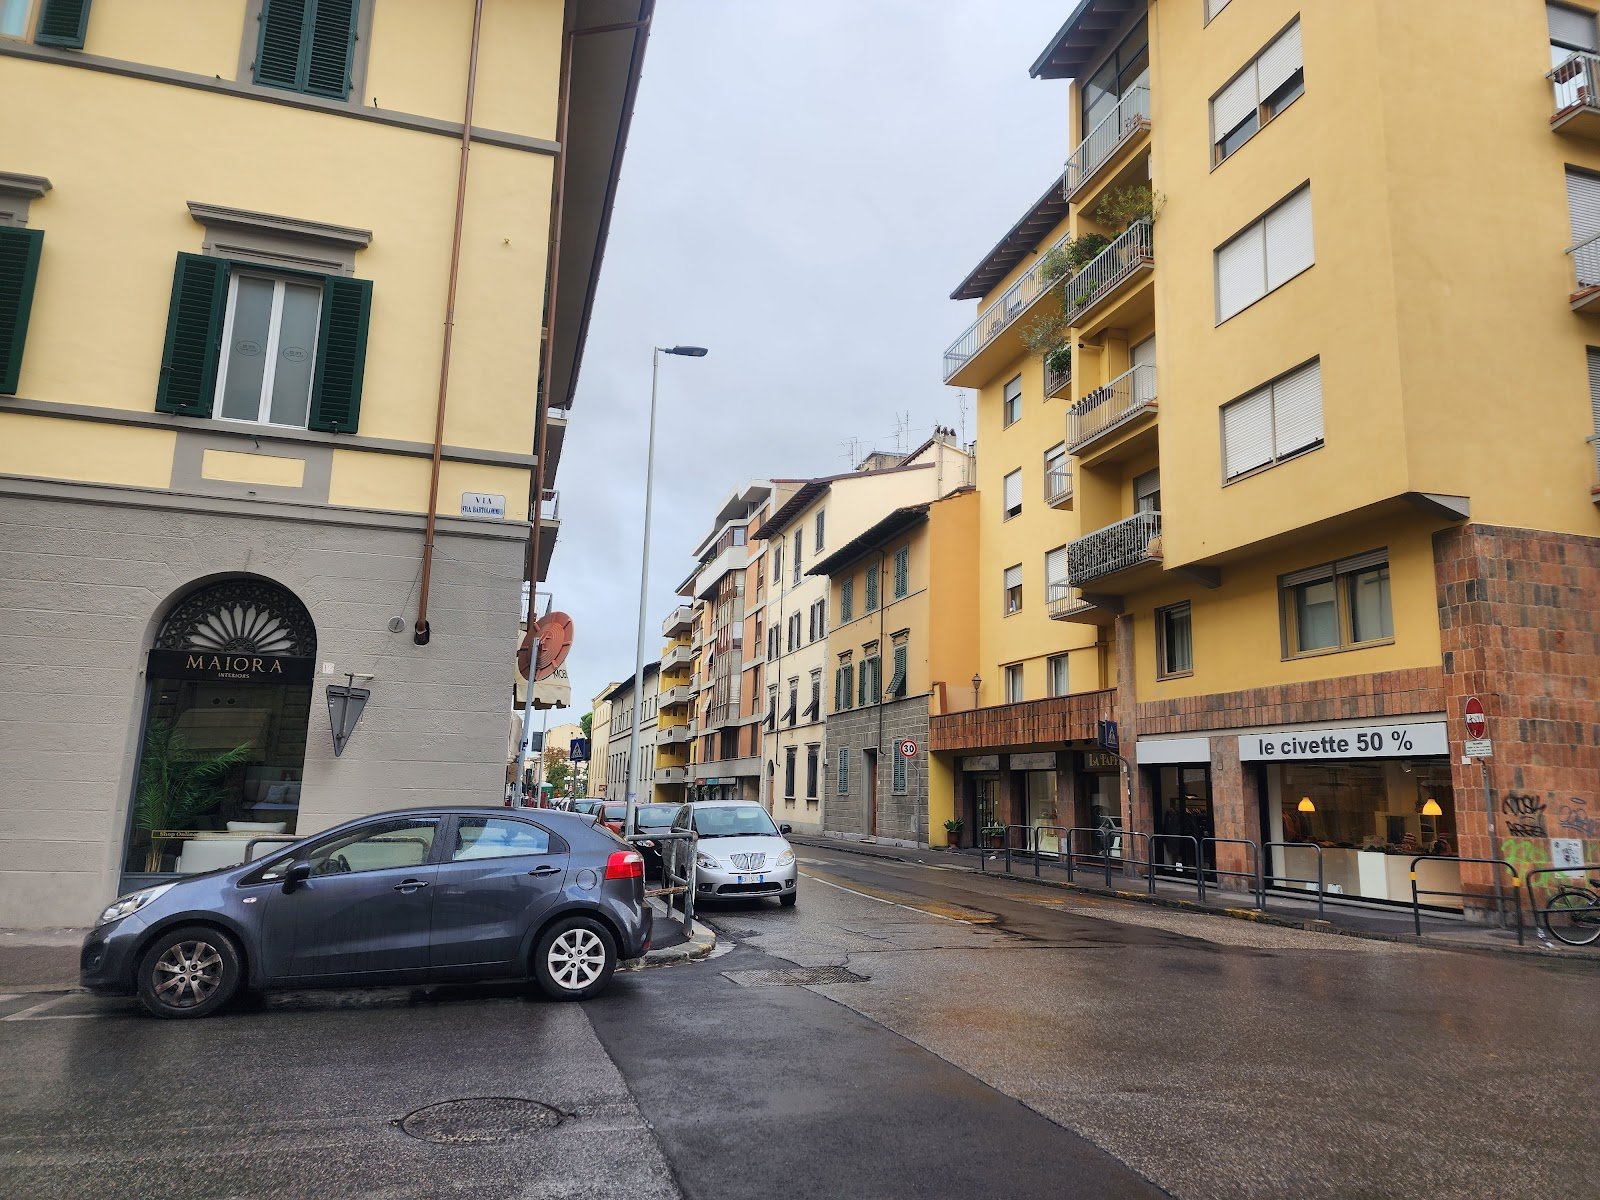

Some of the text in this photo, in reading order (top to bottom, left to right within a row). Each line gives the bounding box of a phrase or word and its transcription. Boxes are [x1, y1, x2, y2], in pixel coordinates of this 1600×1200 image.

[475, 496, 492, 505] VIA
[186, 654, 283, 674] MAIORA
[904, 744, 914, 752] 30
[1258, 730, 1413, 756] le civette 50 %
[1088, 753, 1100, 767] LA
